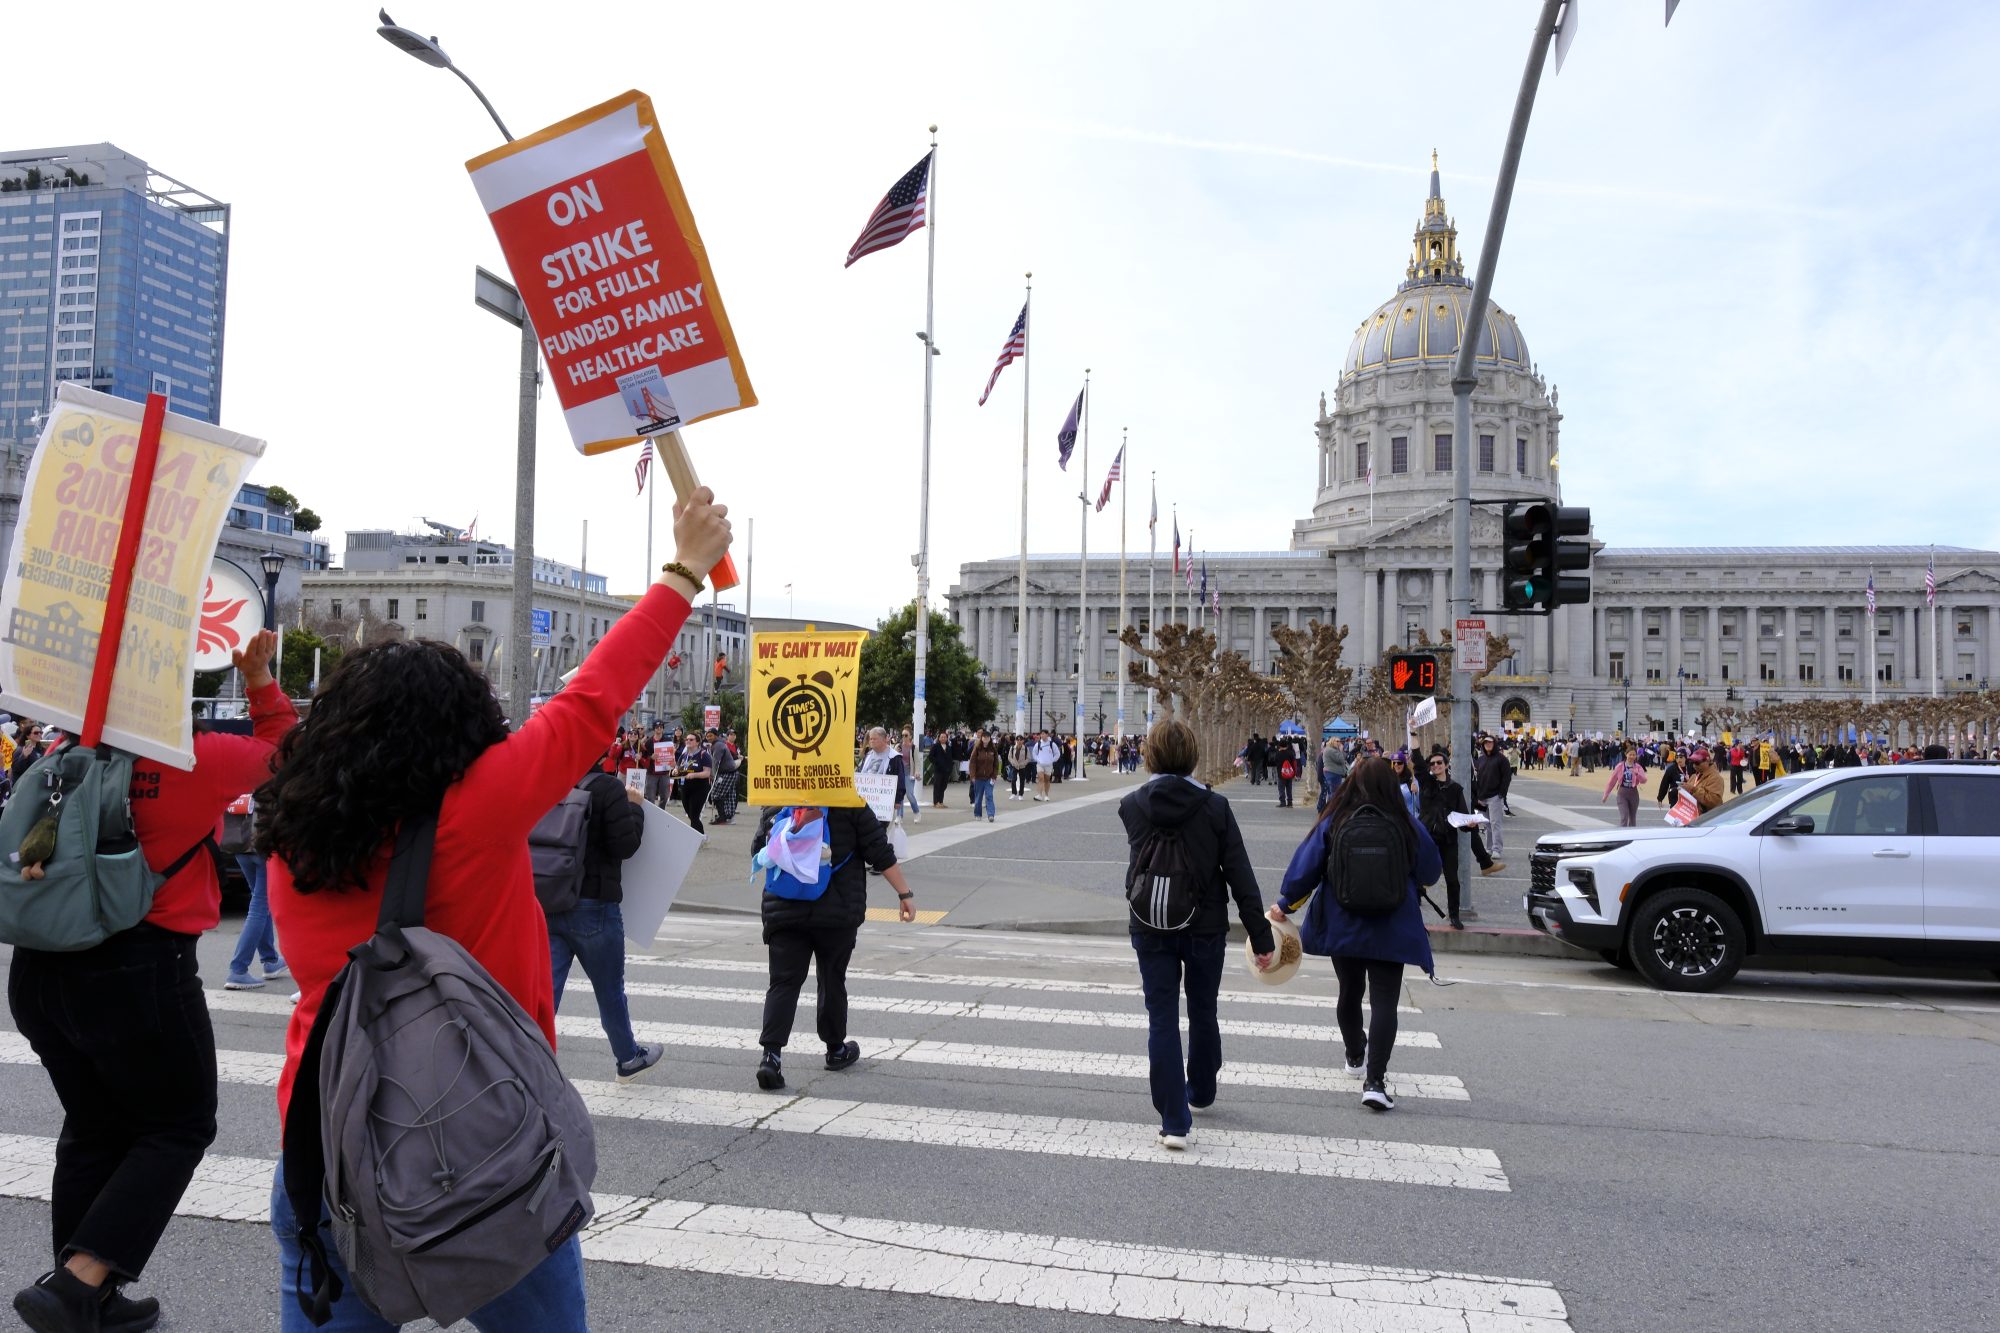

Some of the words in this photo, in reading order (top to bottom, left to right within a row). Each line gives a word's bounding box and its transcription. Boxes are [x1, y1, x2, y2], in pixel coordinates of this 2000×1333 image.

[547, 179, 603, 227] ON
[541, 219, 652, 288] STRIKE
[553, 287, 597, 319] FOR
[595, 259, 661, 302] FULLY
[543, 315, 619, 358] FUNDED
[621, 283, 704, 329] FAMILY
[567, 322, 704, 385] HEALTHCARE
[1458, 628, 1465, 640] NO
[758, 641, 778, 659] WE
[781, 641, 821, 659] CAN'T
[824, 641, 858, 658] WAIT
[1420, 662, 1434, 687] 13
[786, 699, 816, 713] TIME'S
[787, 711, 820, 741] UP
[754, 777, 771, 789] OUR
[774, 777, 816, 790] STUDENTS
[818, 776, 852, 789] DESERVE
[765, 765, 781, 776] FOR
[784, 765, 800, 777] THE
[804, 764, 840, 777] SCHOOLS
